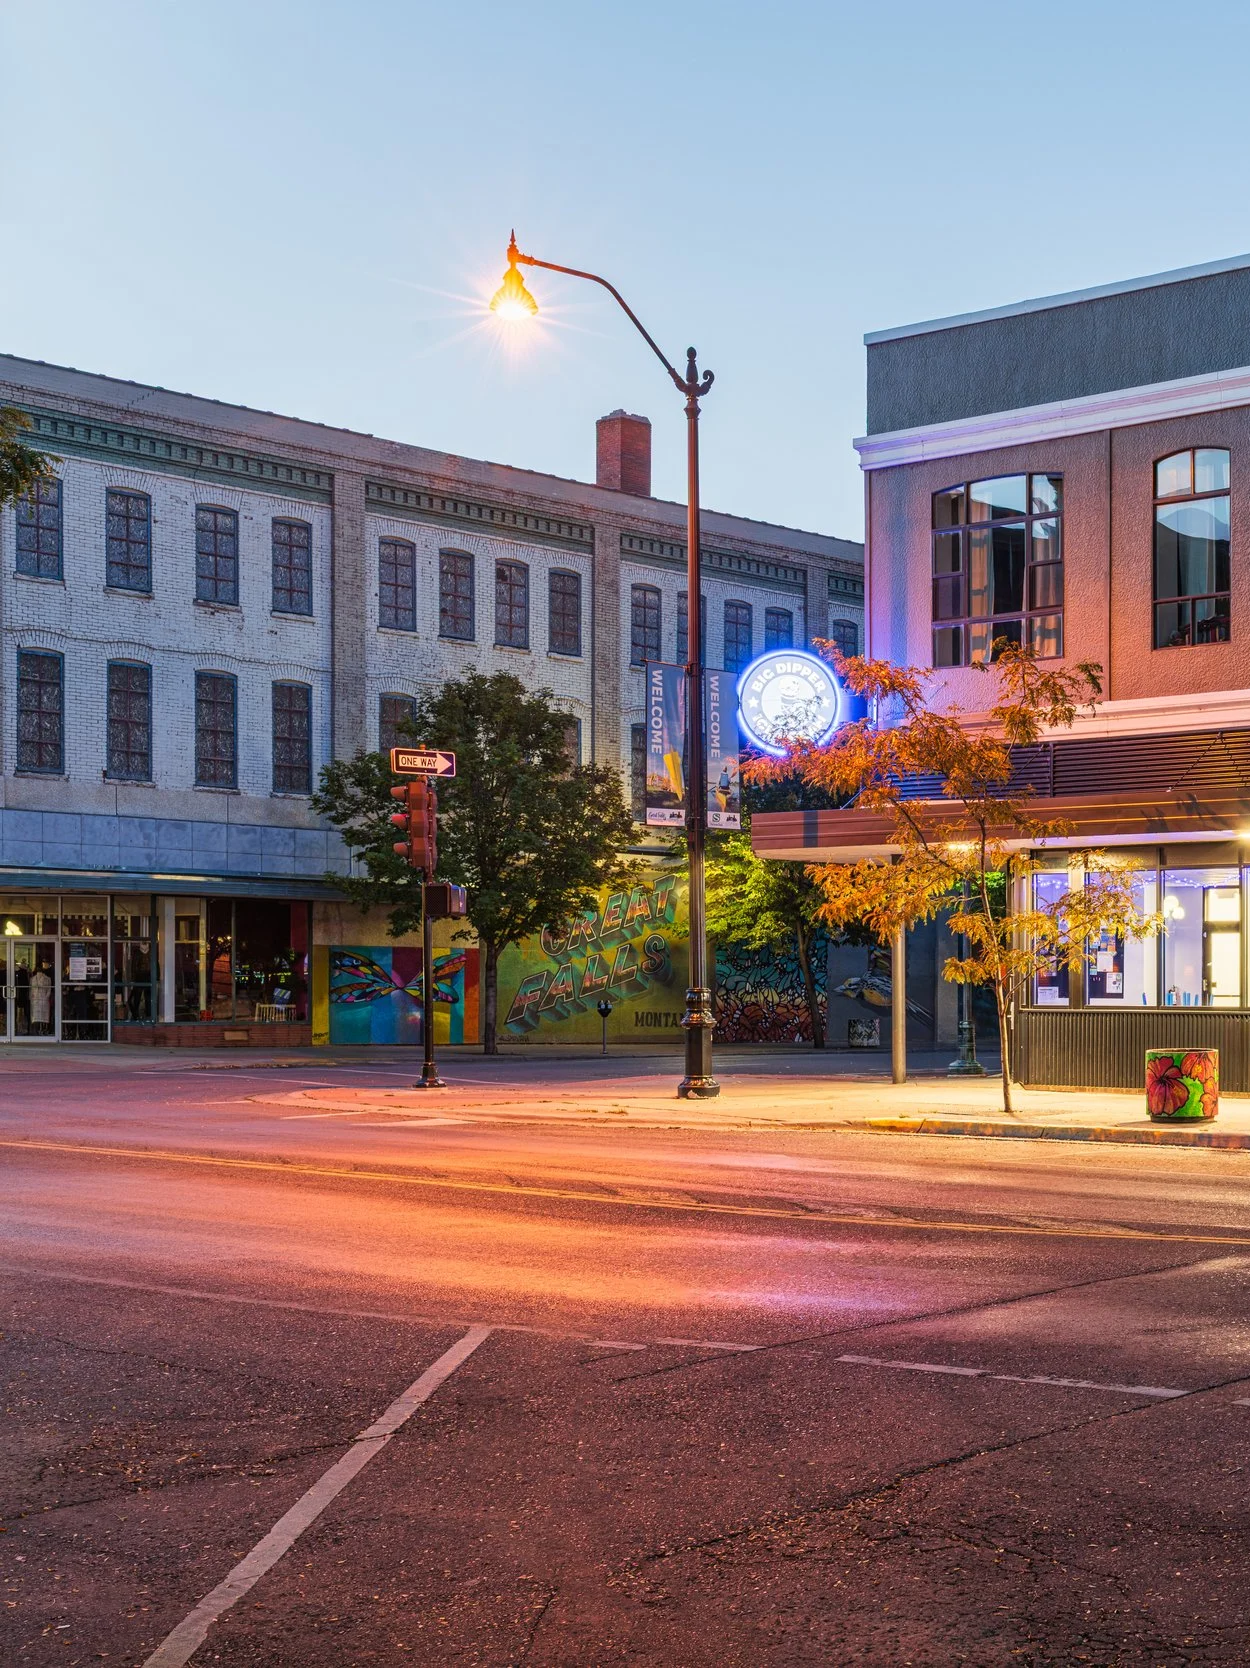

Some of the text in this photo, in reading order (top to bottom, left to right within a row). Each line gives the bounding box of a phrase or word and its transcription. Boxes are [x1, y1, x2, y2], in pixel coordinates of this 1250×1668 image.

[751, 662, 826, 693] BIG DIPPER
[651, 670, 663, 754] WELCOME
[710, 675, 720, 758] WELCOME
[401, 756, 437, 767] ONE WAY
[504, 933, 666, 1026] FALLS
[634, 1011, 686, 1028] MONTA
